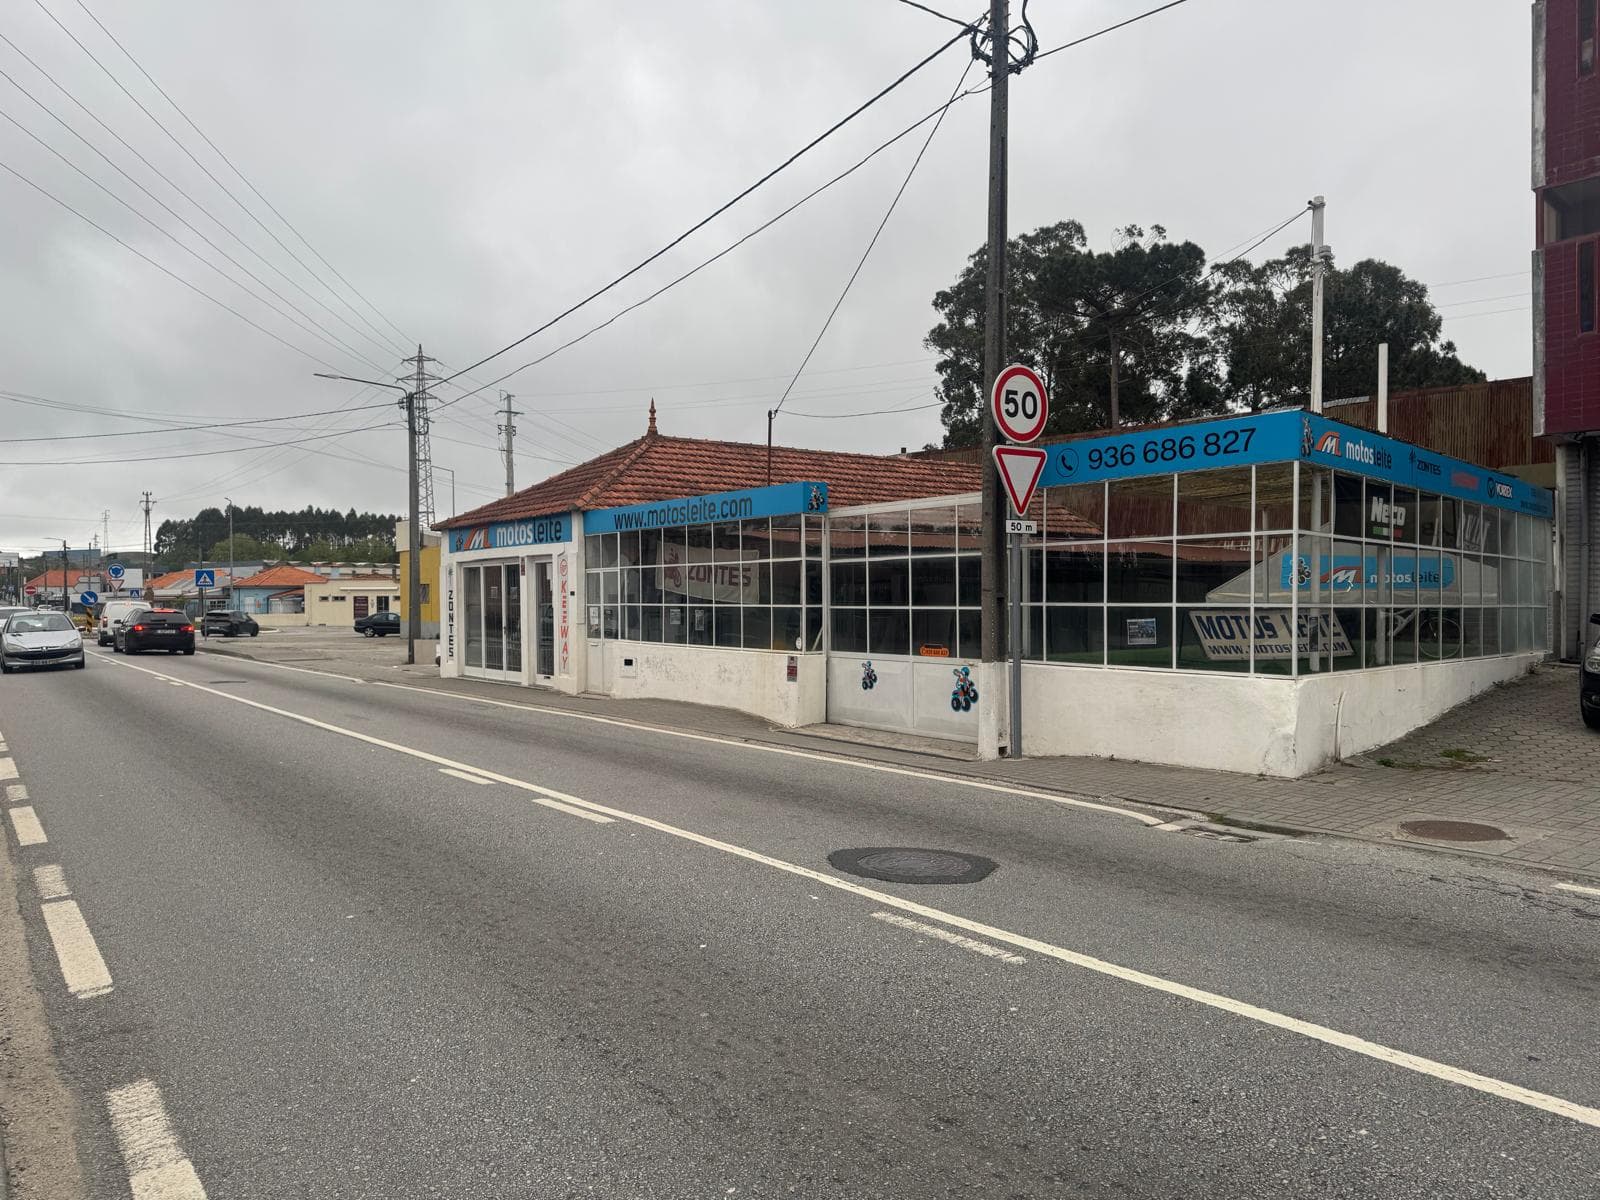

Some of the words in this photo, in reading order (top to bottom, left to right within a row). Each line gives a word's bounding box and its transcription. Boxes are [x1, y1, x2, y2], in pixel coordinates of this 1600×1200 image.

[1004, 389, 1038, 420] 50
[1088, 443, 1135, 471] 936
[1142, 435, 1196, 464] 686
[1203, 427, 1257, 457] 827
[1345, 440, 1393, 470] motosleite
[613, 496, 754, 531] www.motosleite.com
[1010, 522, 1022, 532] 50
[496, 518, 562, 547] motosleite
[687, 564, 752, 587] ZONTES
[447, 590, 455, 658] ZONTES
[1195, 615, 1279, 640] MOTOS
